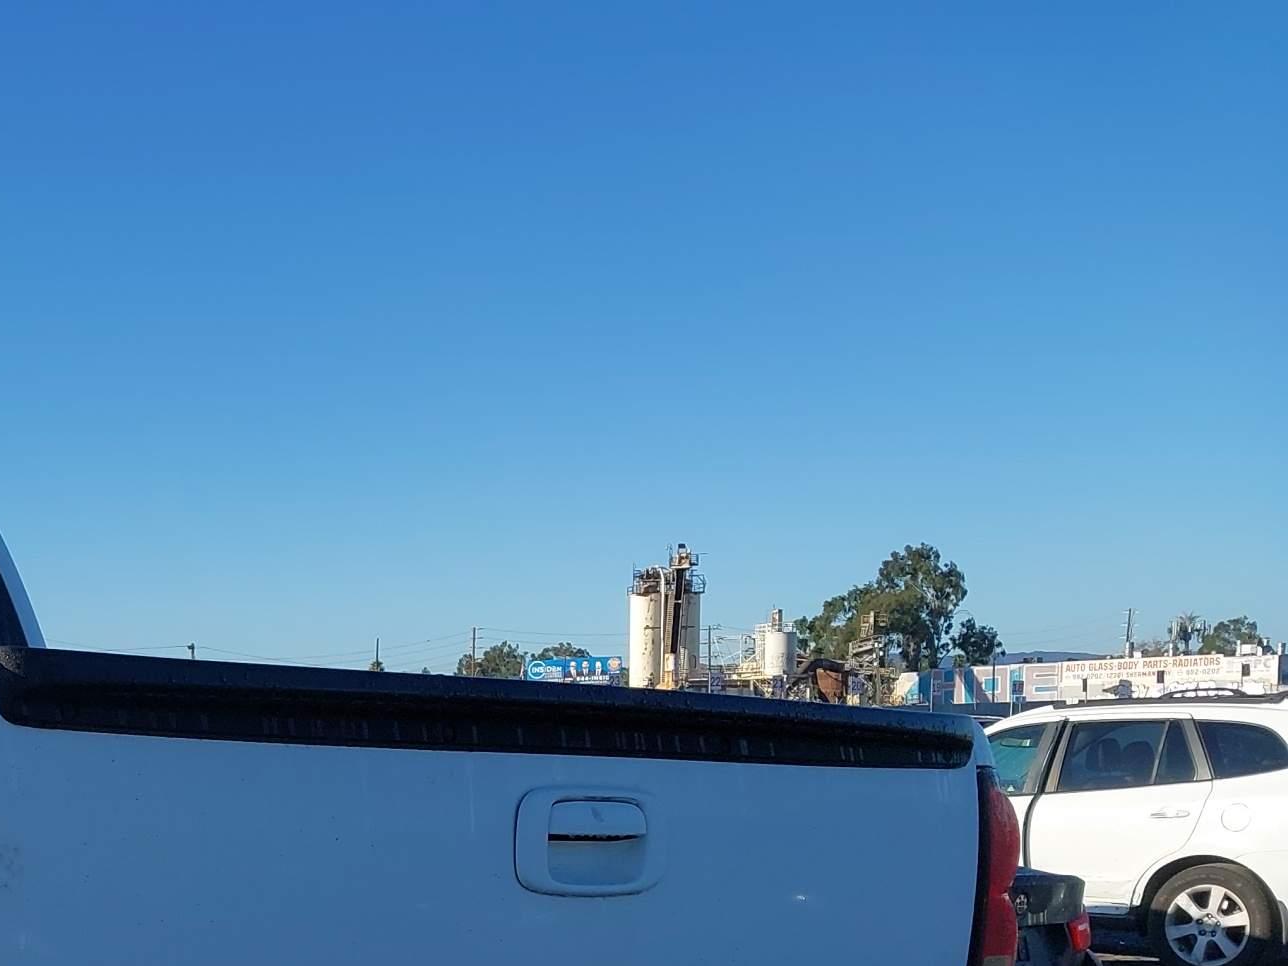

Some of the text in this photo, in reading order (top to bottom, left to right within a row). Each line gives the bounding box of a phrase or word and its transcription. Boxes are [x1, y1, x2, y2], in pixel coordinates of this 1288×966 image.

[1065, 663, 1086, 672] AUTO
[711, 676, 721, 687] 22
[852, 681, 862, 691] 20
